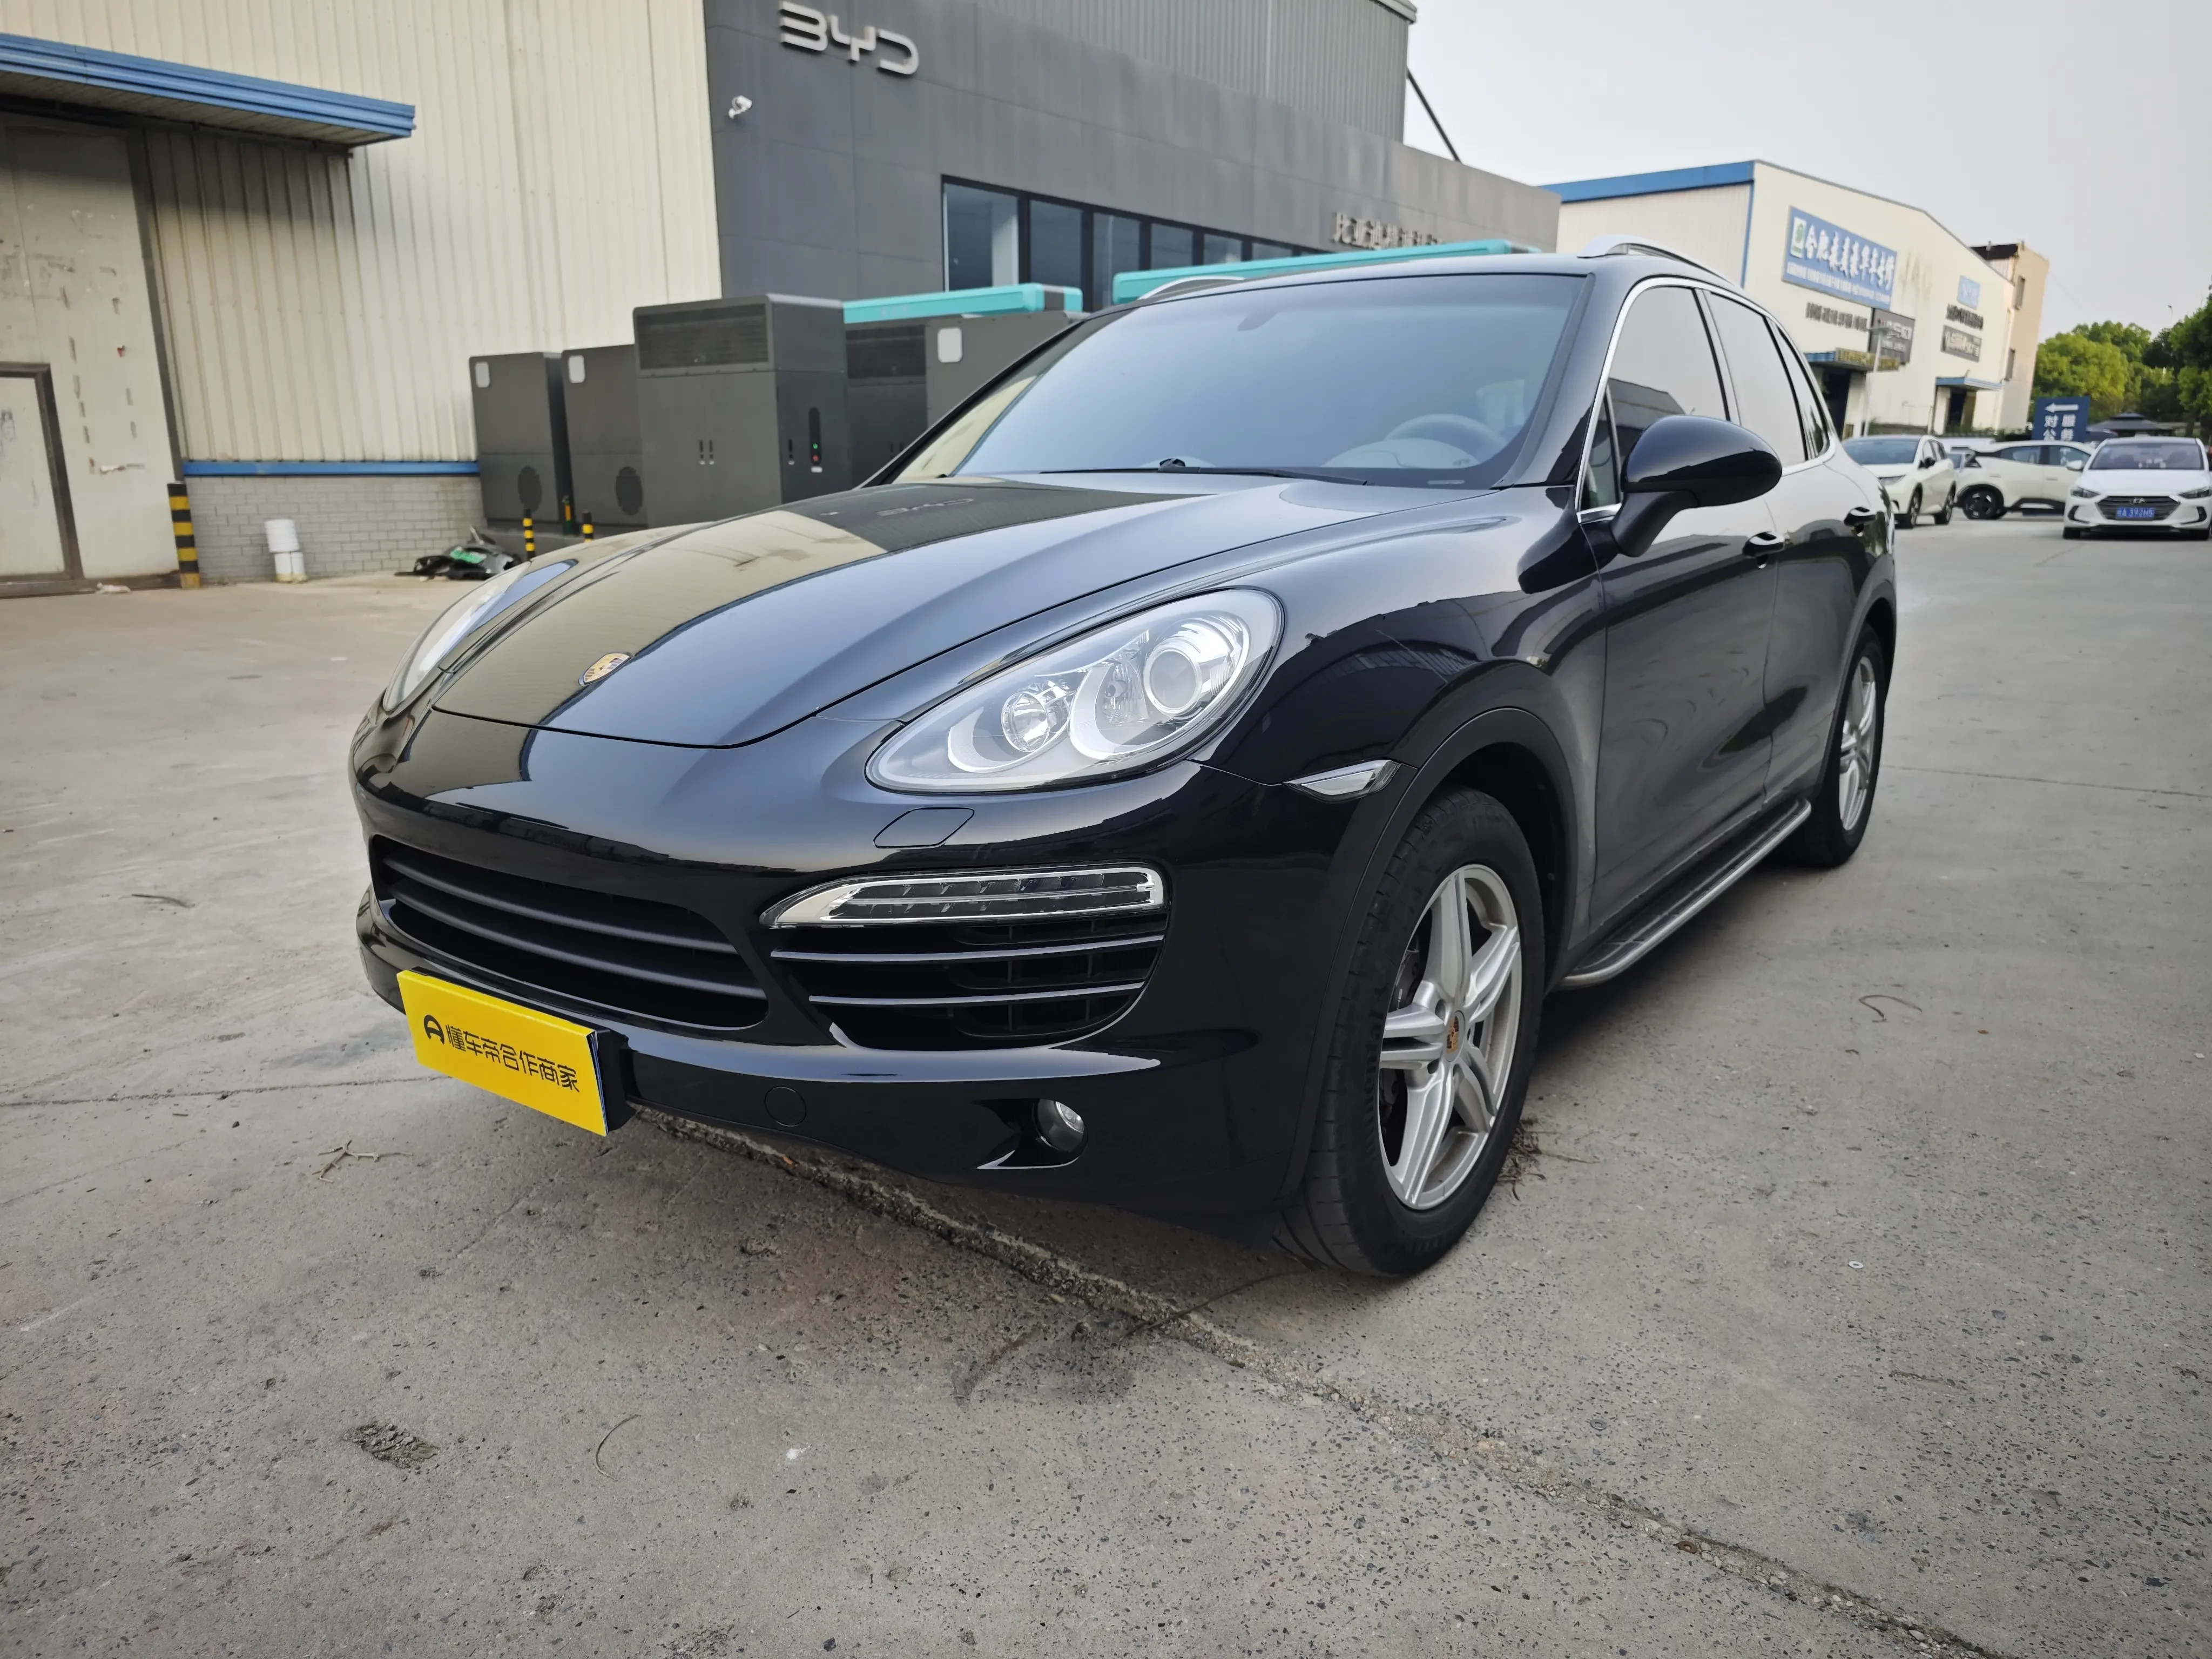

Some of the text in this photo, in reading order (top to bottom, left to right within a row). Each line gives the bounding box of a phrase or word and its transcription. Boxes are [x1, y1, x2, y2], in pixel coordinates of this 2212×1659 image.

[780, 1, 919, 75] BYD
[446, 1024, 580, 1092] 懂车帝合作商家
